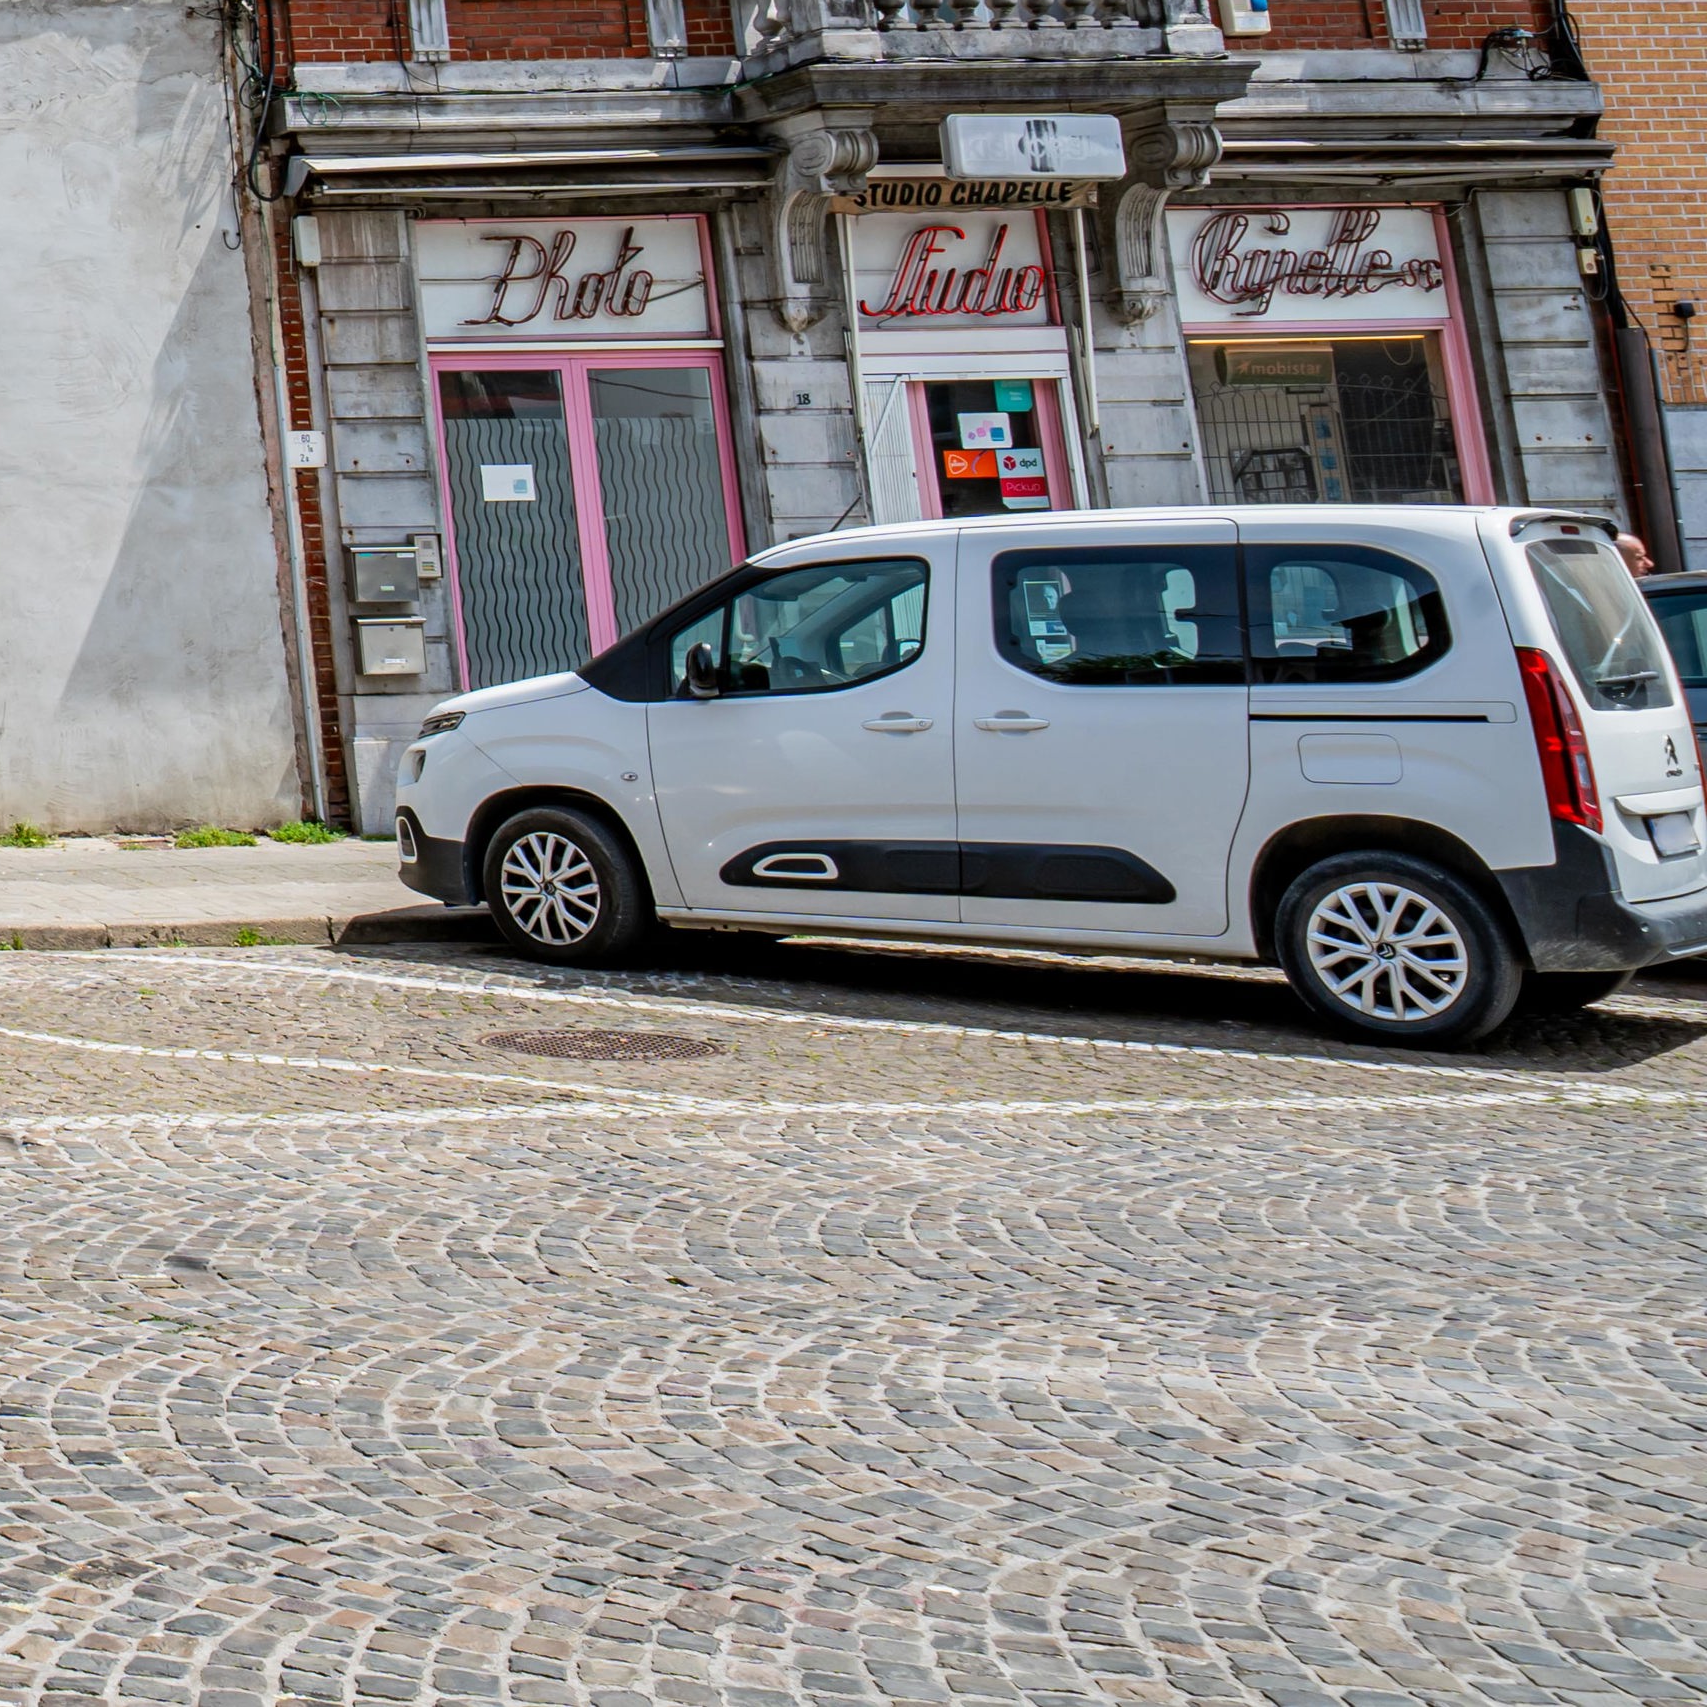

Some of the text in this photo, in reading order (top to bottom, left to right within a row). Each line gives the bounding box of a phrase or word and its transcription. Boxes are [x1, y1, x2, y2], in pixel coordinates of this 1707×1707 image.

[853, 181, 1074, 208] STUDIO CHAPELLE
[858, 223, 1046, 317] Studio
[1192, 209, 1393, 316] Chapelle
[458, 226, 654, 327] Photo
[1251, 360, 1322, 375] mobistar
[796, 393, 811, 405] 18
[1019, 458, 1037, 469] dpd
